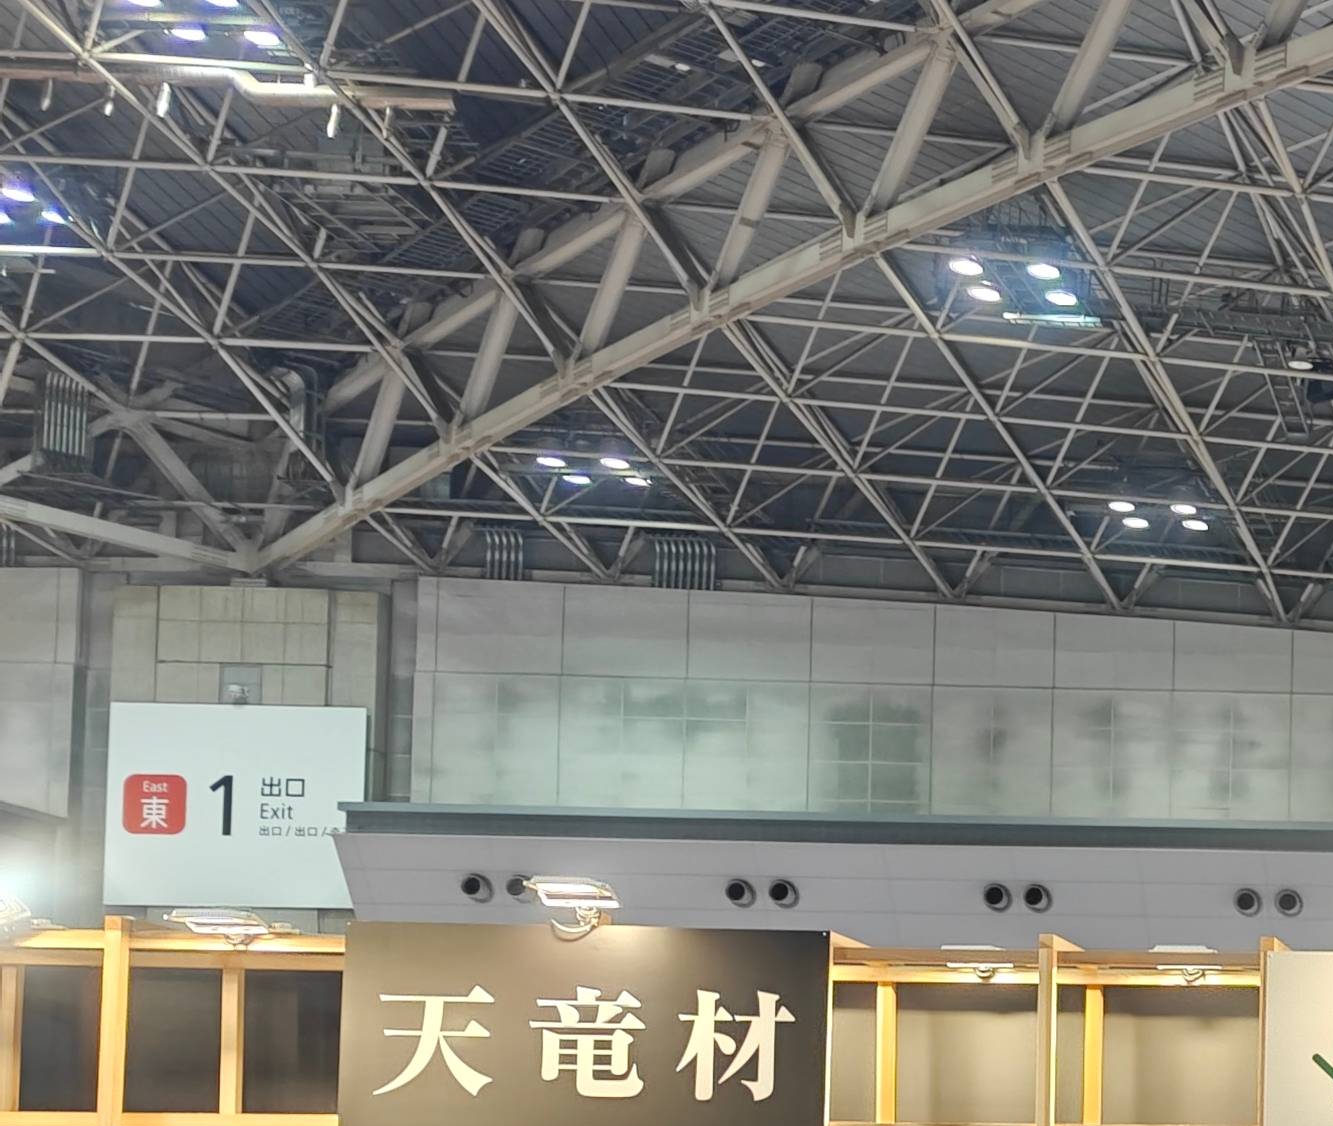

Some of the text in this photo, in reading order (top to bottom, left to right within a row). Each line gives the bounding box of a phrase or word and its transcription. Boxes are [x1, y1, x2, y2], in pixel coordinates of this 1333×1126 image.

[142, 780, 169, 794] East
[260, 776, 305, 798] 出口
[140, 796, 170, 829] 東
[209, 775, 234, 836] 1
[260, 803, 293, 820] Exit
[259, 826, 281, 836] 出口
[295, 826, 318, 837] 出口
[372, 985, 796, 1102] 天竜材
